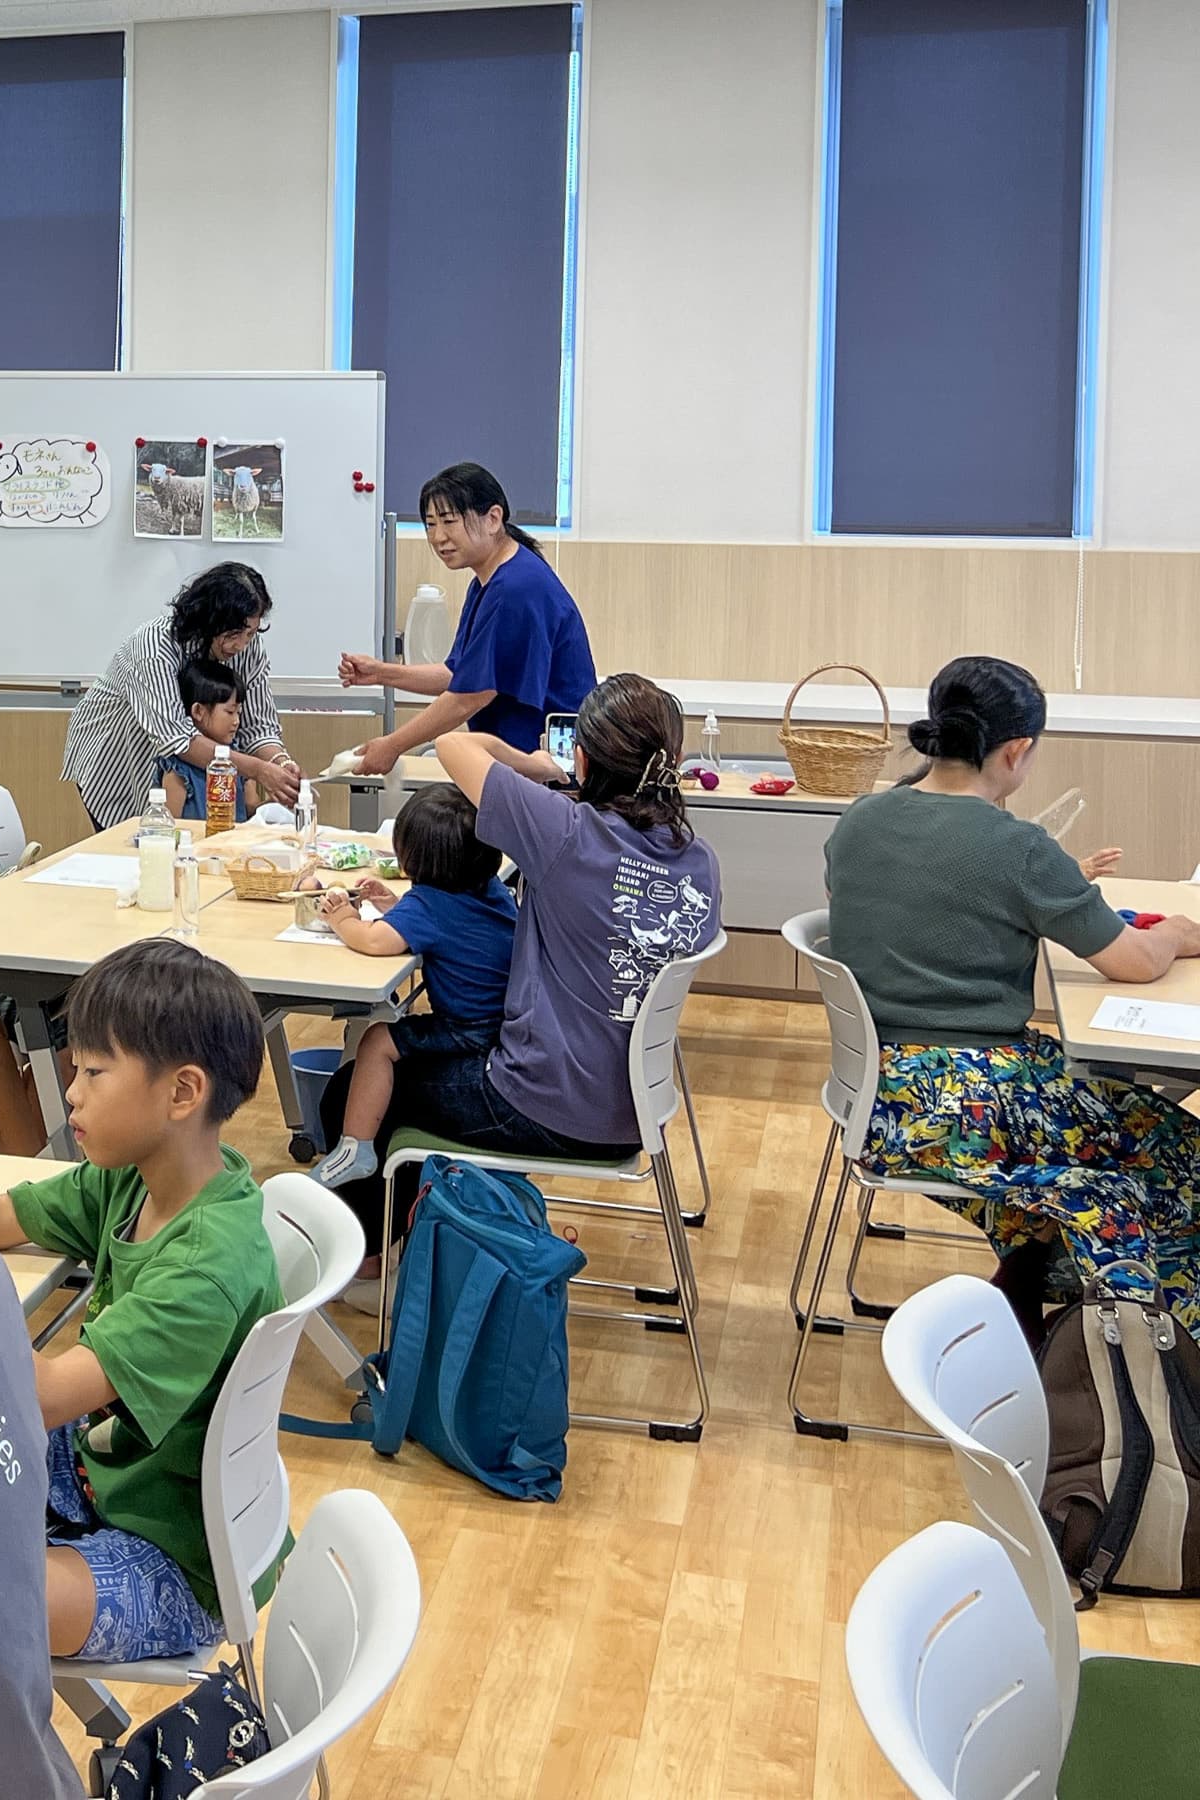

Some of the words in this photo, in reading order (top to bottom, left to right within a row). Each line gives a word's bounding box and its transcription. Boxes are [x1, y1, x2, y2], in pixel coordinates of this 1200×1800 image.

[214, 775, 231, 802] 麦茶
[615, 874, 641, 886] ISLAND
[613, 883, 644, 897] OKINAWA
